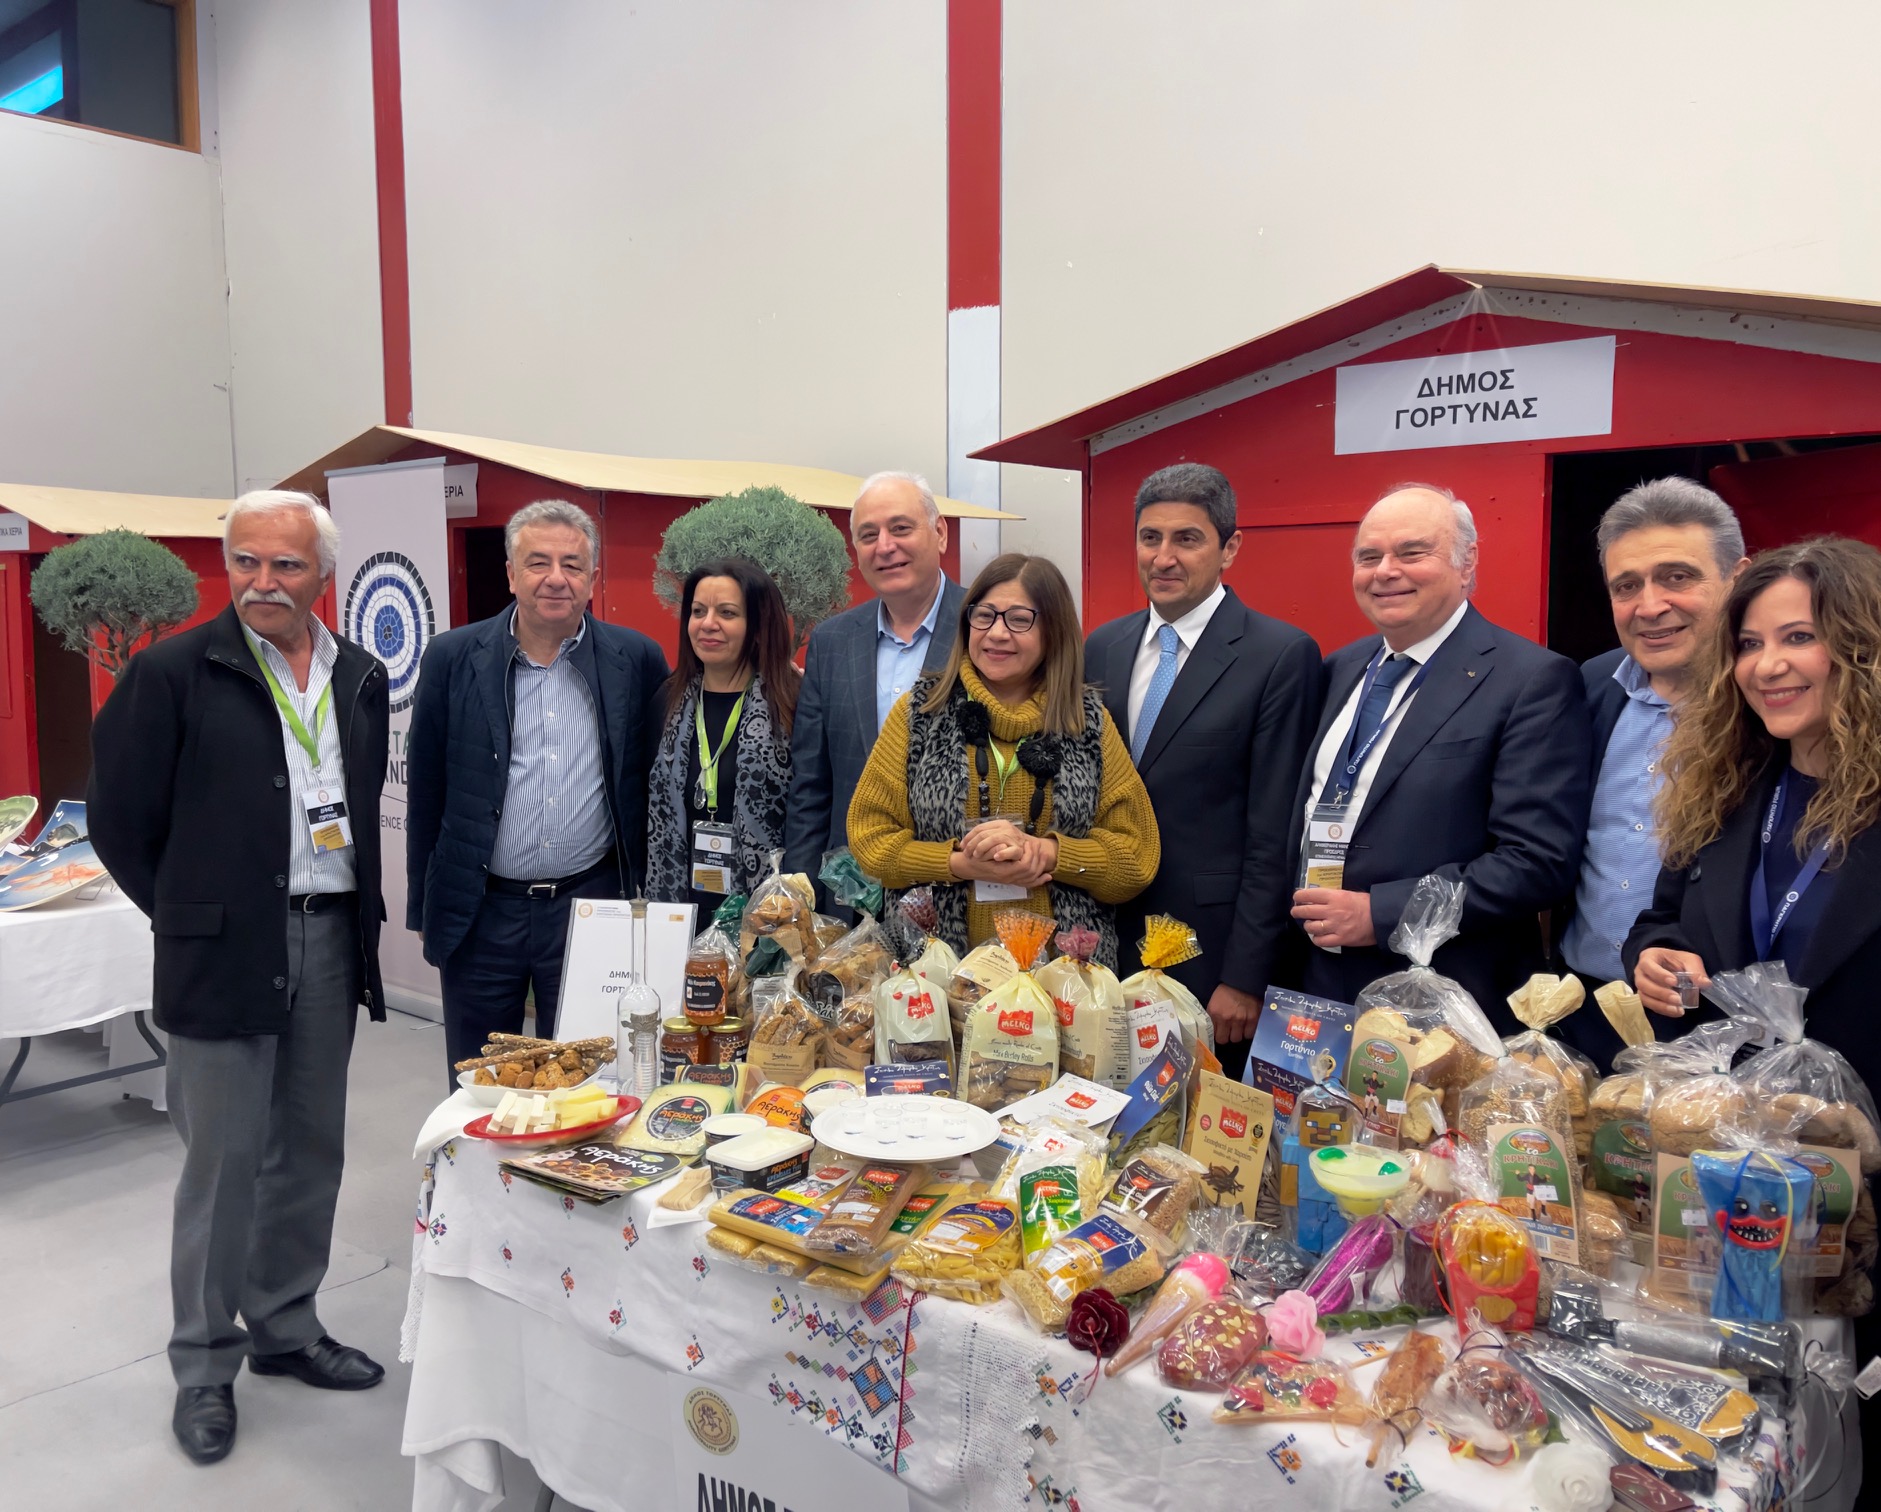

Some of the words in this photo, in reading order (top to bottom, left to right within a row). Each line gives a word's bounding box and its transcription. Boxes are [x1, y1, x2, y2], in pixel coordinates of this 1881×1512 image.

[1417, 368, 1515, 398] ΔΗΜΟΣ
[1395, 397, 1538, 430] ΓΟΡΤΥΝΑΣ
[1001, 1020, 1030, 1031] MELKO
[1280, 1040, 1316, 1056] Γορτύνιο
[1222, 1119, 1244, 1133] MELKO
